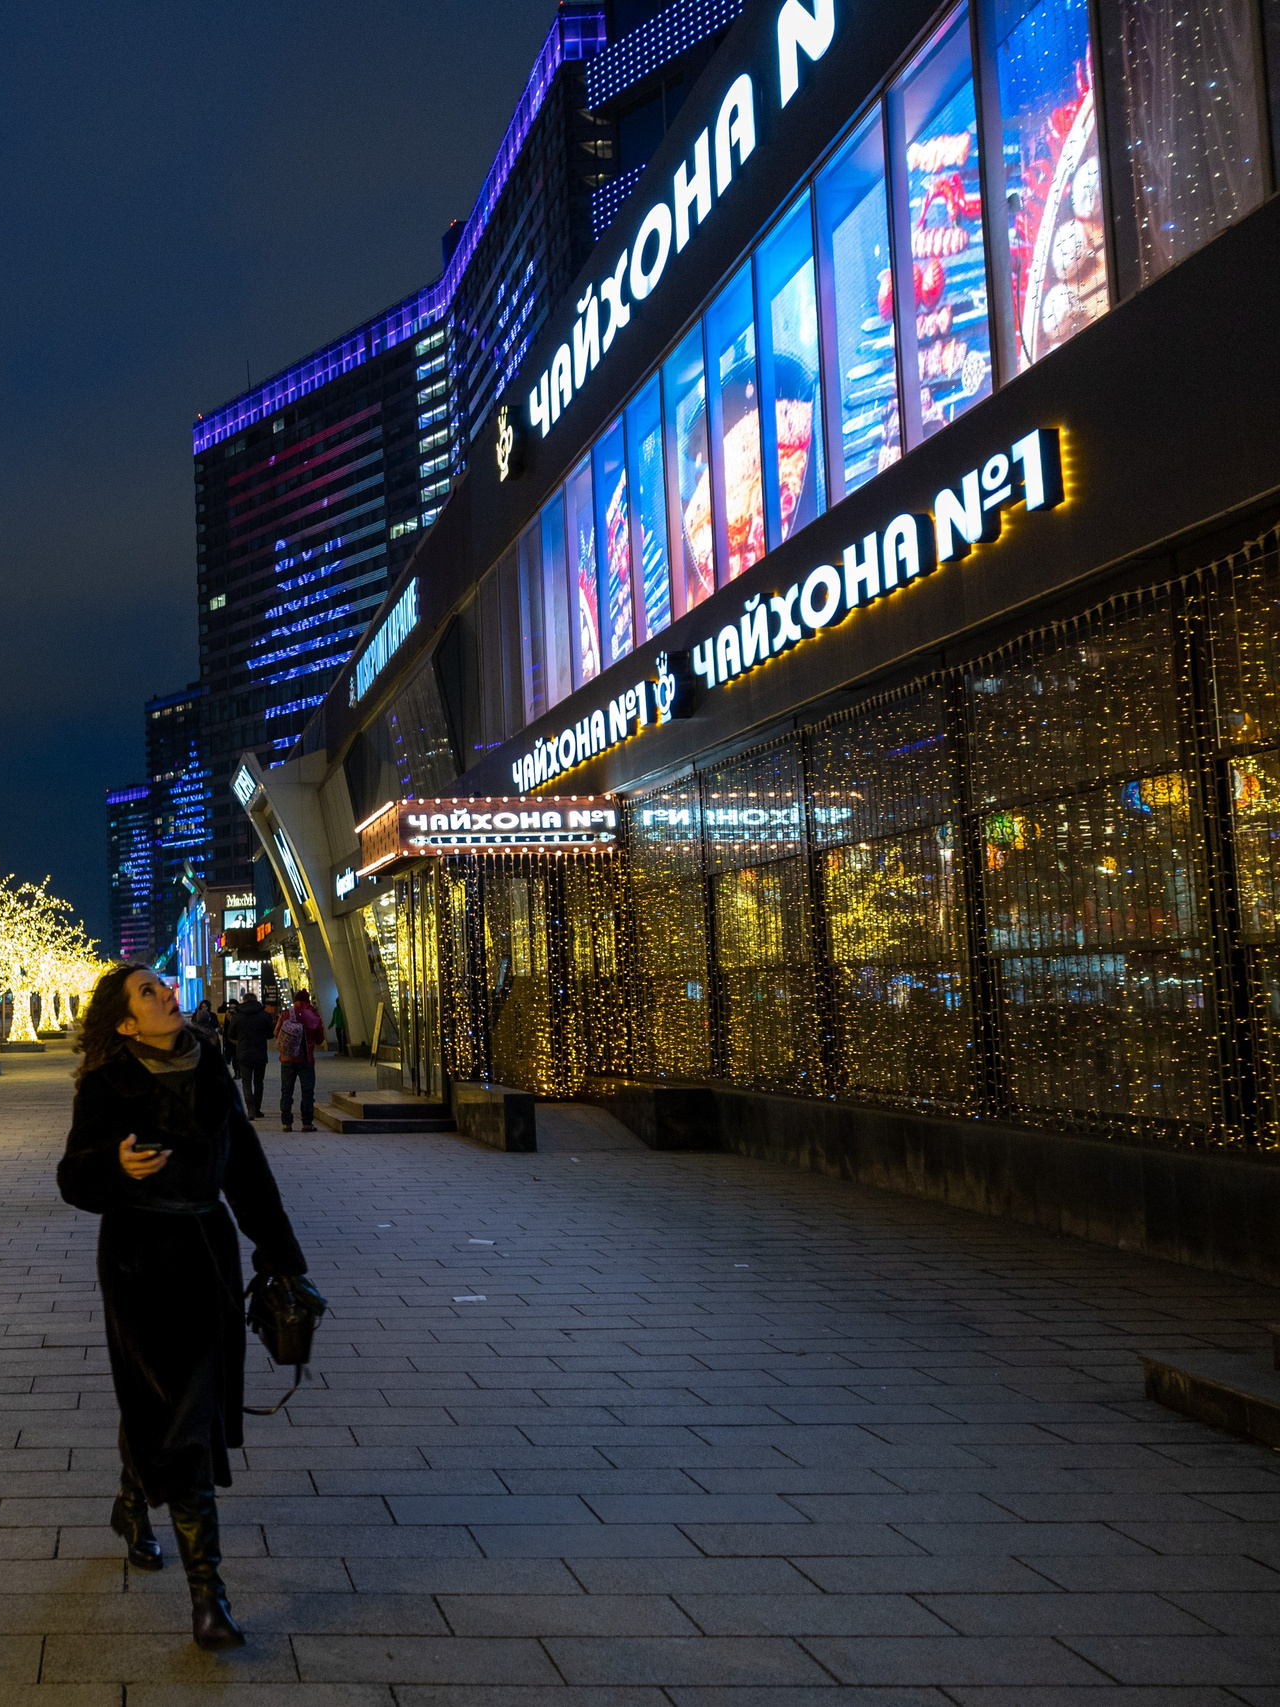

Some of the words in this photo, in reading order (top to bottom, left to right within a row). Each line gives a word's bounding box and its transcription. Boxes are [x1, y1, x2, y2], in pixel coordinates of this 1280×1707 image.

[529, 73, 756, 438] ЧАЙХОНА
[692, 513, 920, 690] ЧАЙХОНА
[512, 709, 606, 793] ЧАЙХОНА
[408, 807, 561, 831] ЧАЙХОНА
